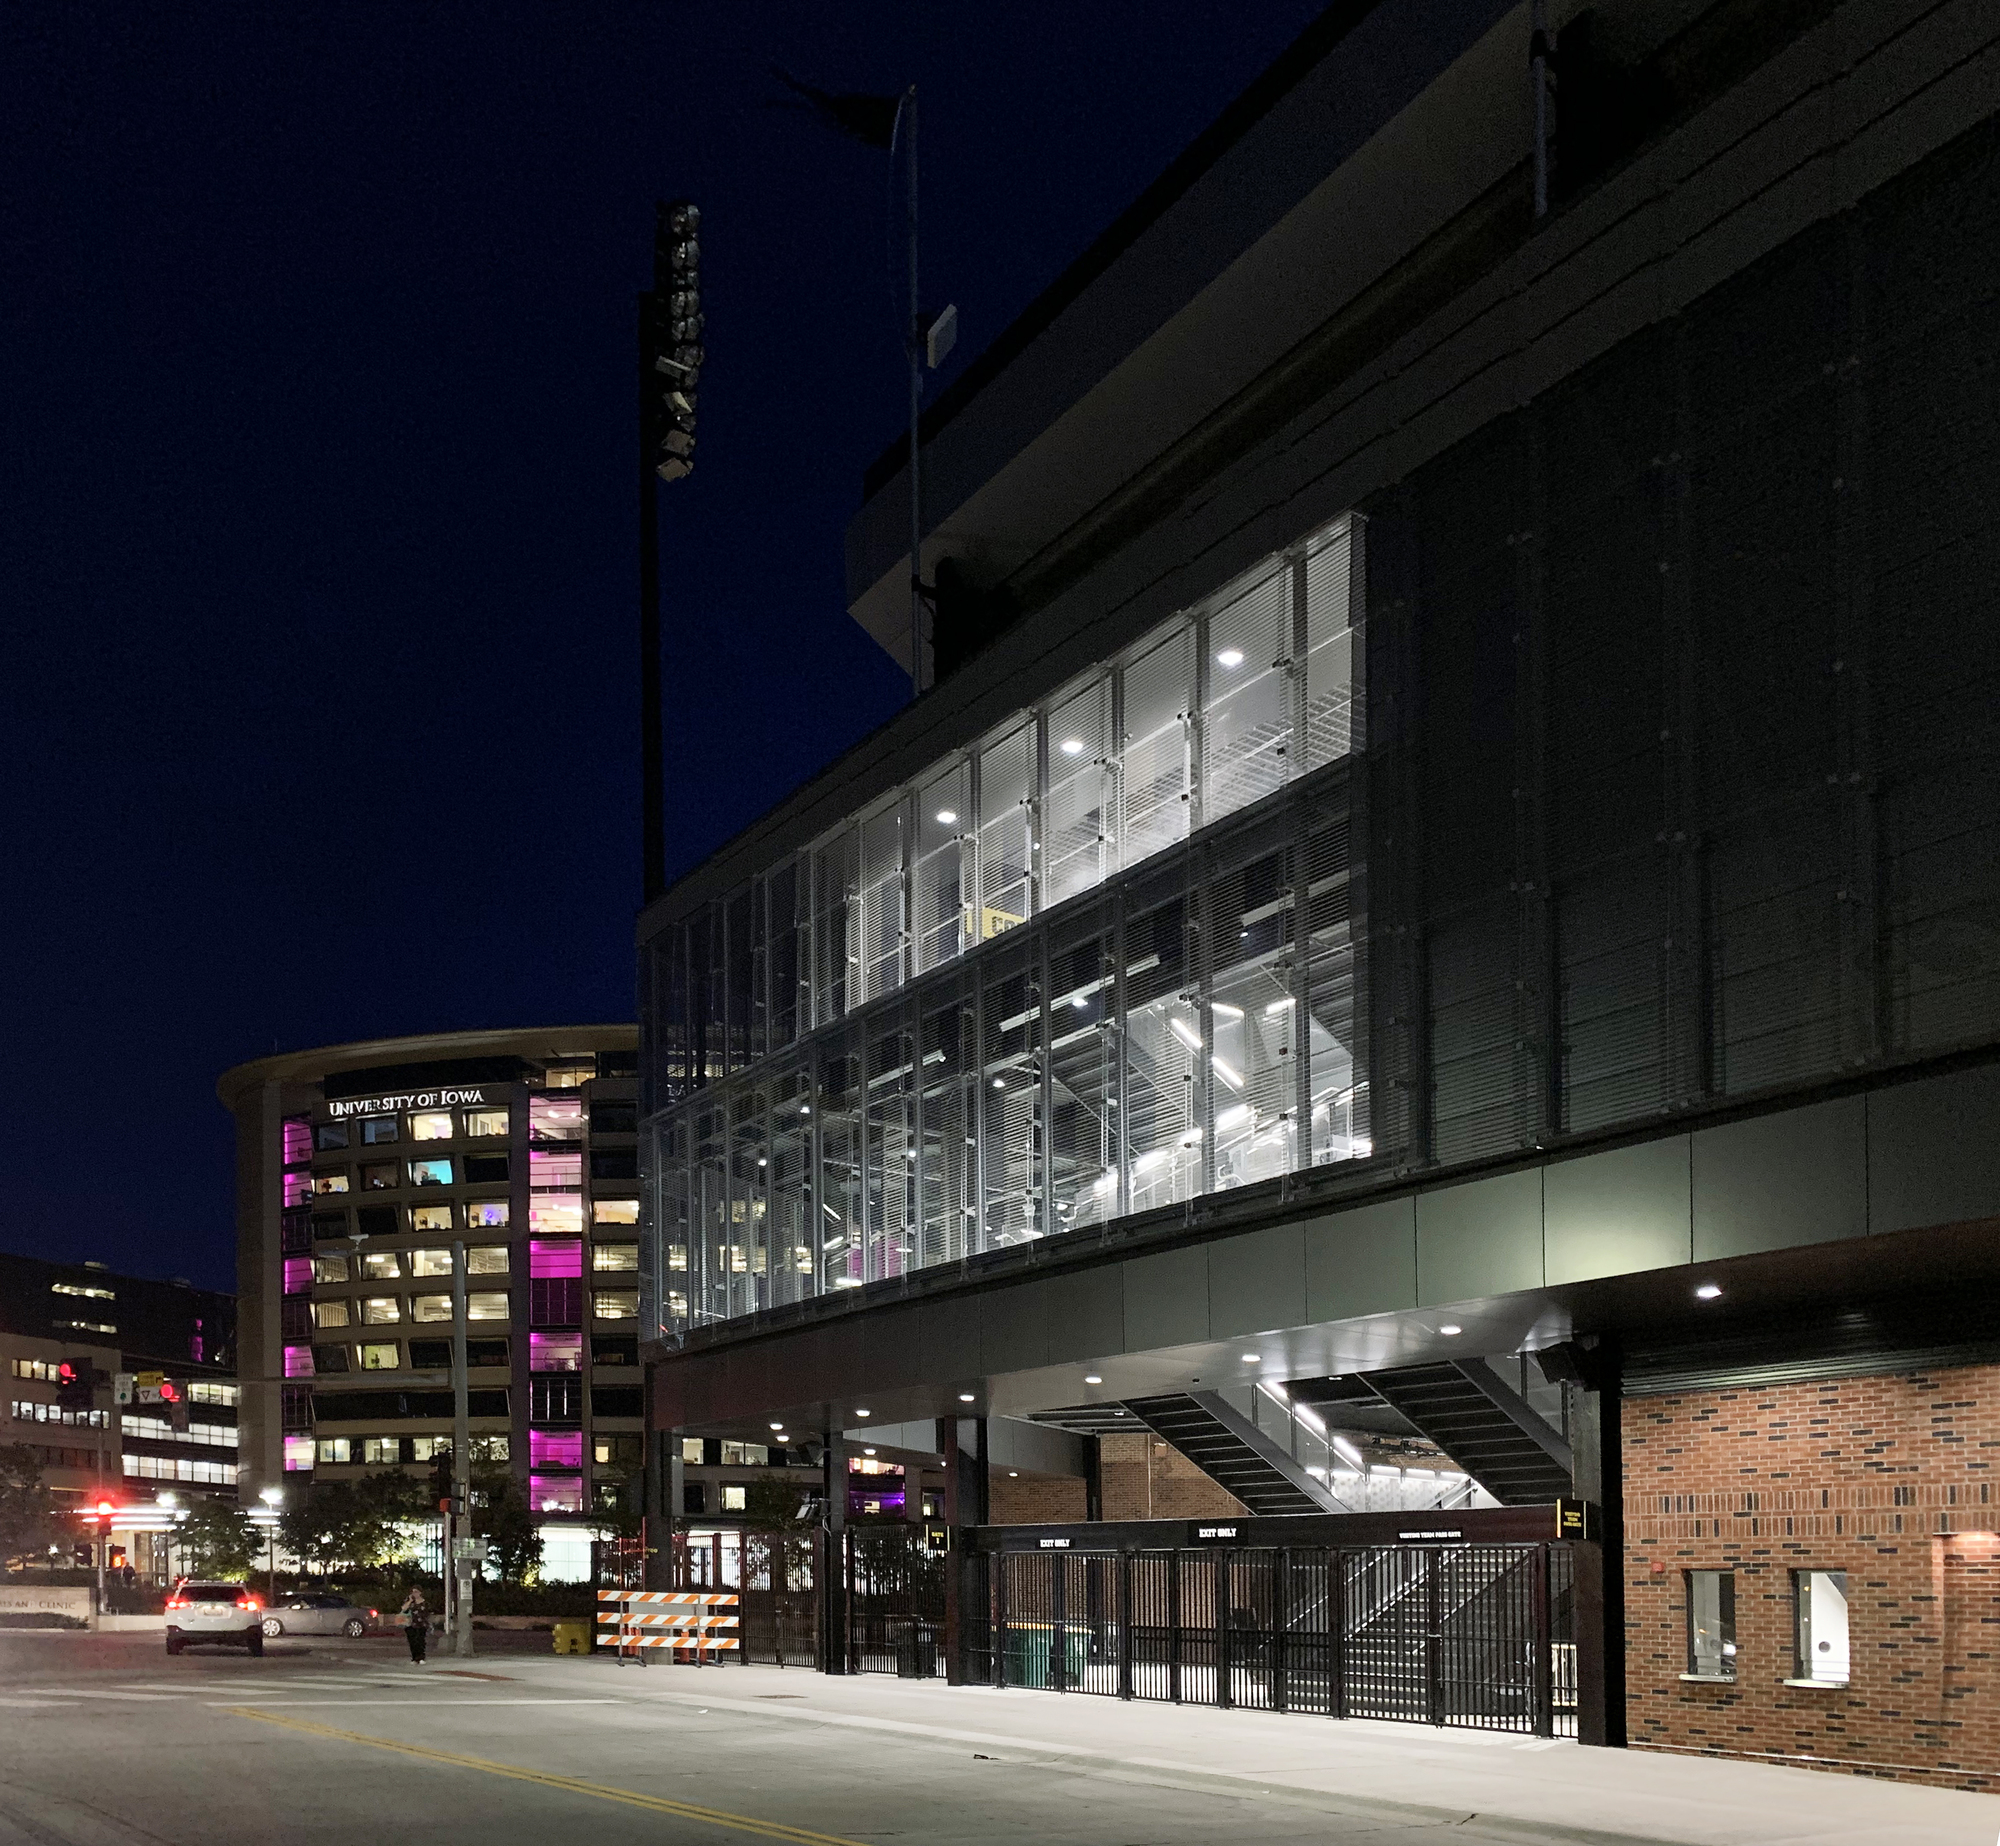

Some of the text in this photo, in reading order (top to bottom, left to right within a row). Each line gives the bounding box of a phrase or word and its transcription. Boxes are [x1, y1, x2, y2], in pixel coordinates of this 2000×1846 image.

[329, 1090, 485, 1116] UNIVERSITY OF IOWA
[1199, 1528, 1236, 1537] EXIT ONLY
[1040, 1539, 1070, 1547] EXIT ONLY
